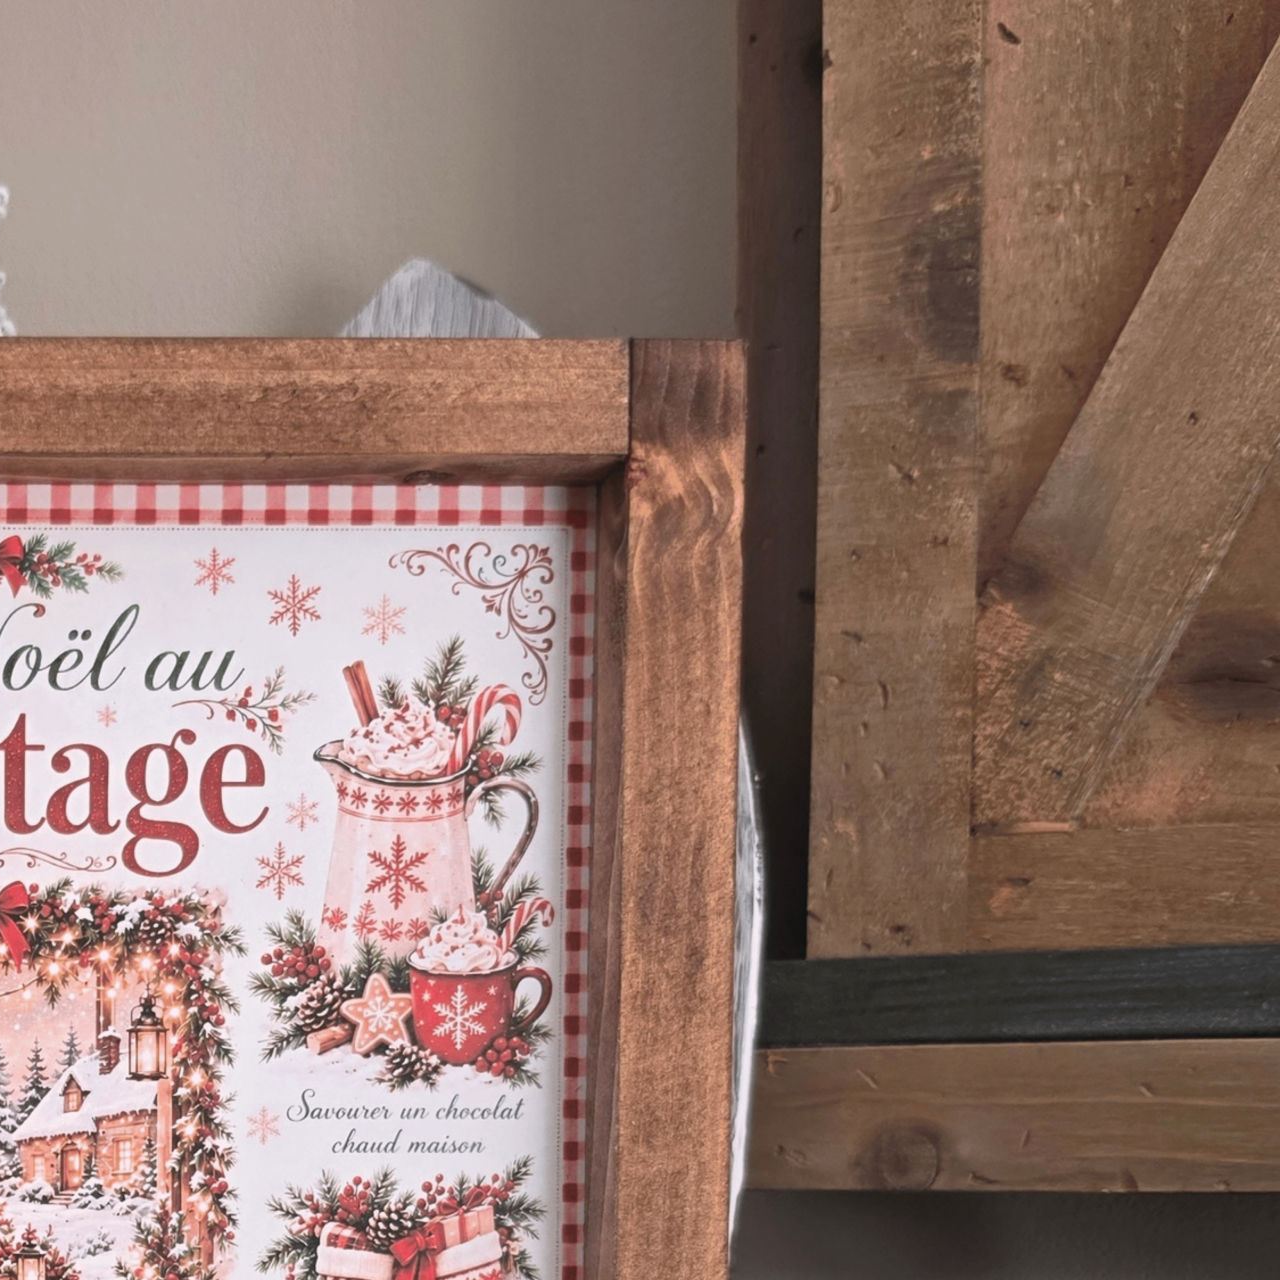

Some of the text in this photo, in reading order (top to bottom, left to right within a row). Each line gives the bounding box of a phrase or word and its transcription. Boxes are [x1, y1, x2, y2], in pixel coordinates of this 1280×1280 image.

[144, 649, 244, 692] au
[286, 1088, 524, 1122] Savourer un chocolat
[332, 1128, 486, 1154] chaud maison
